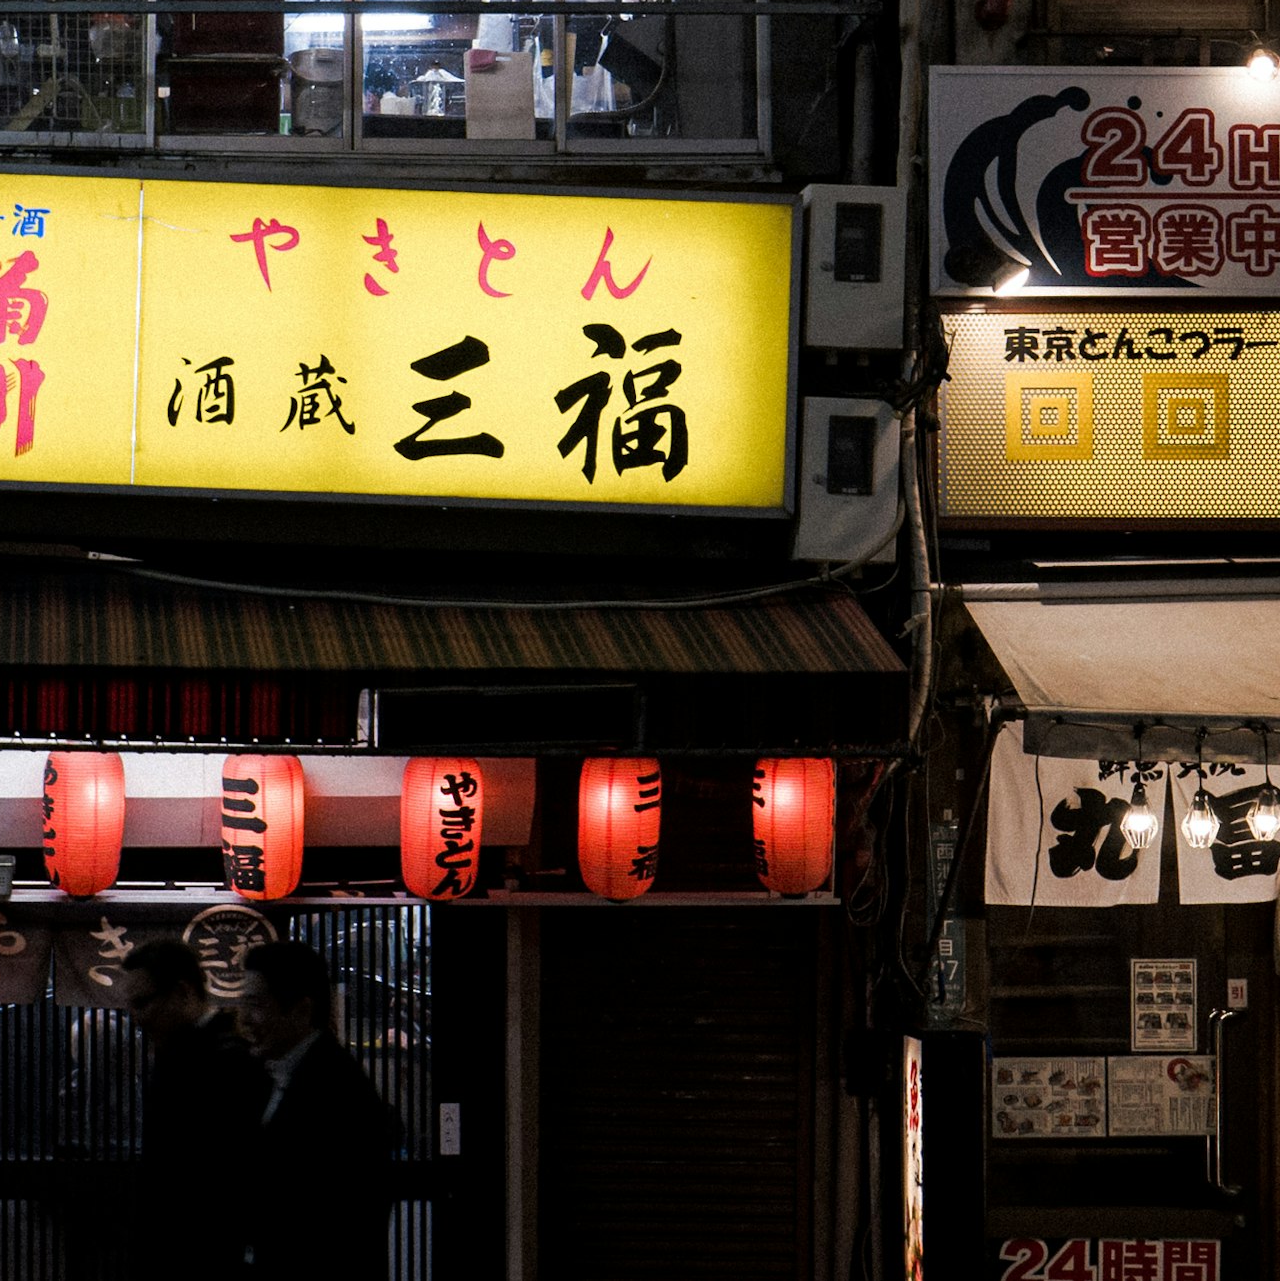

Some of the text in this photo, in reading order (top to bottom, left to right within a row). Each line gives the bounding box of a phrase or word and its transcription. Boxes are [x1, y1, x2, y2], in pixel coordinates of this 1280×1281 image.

[229, 216, 653, 303] やきとん
[166, 322, 692, 485] 酒蔵 三福
[433, 772, 478, 897] やきとん
[999, 1237, 1221, 1281] 24時間
